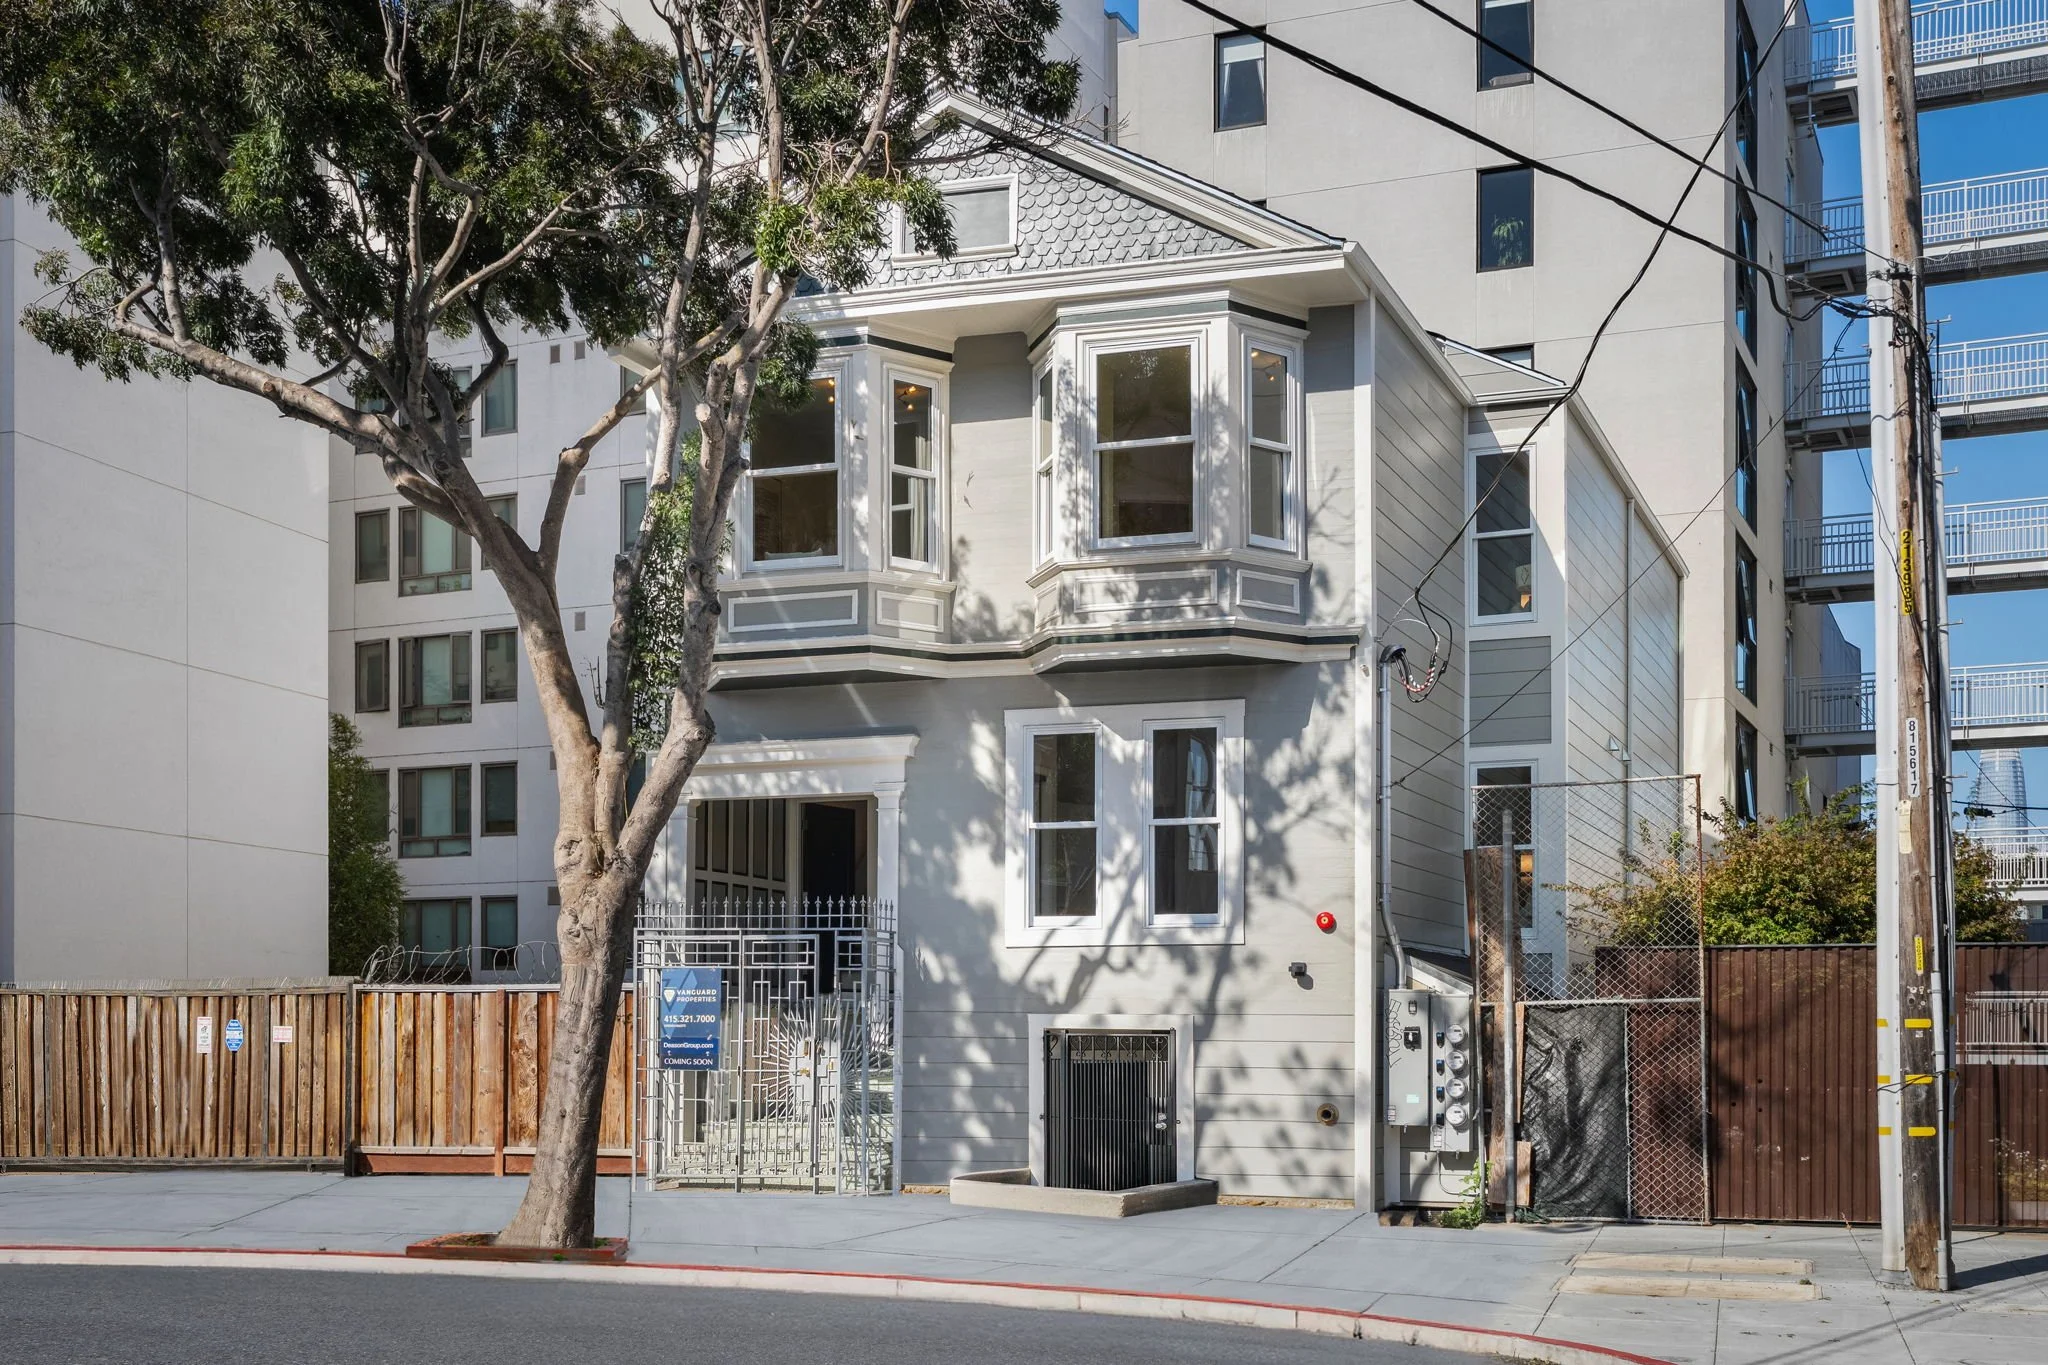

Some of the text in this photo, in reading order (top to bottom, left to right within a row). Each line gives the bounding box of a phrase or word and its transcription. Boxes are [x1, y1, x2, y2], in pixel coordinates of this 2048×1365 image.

[1908, 720, 1917, 795] 815617
[664, 1014, 716, 1023] 415.321.7000
[663, 1042, 714, 1050] DeasonGroup.com
[664, 1057, 713, 1066] COMING SOON
